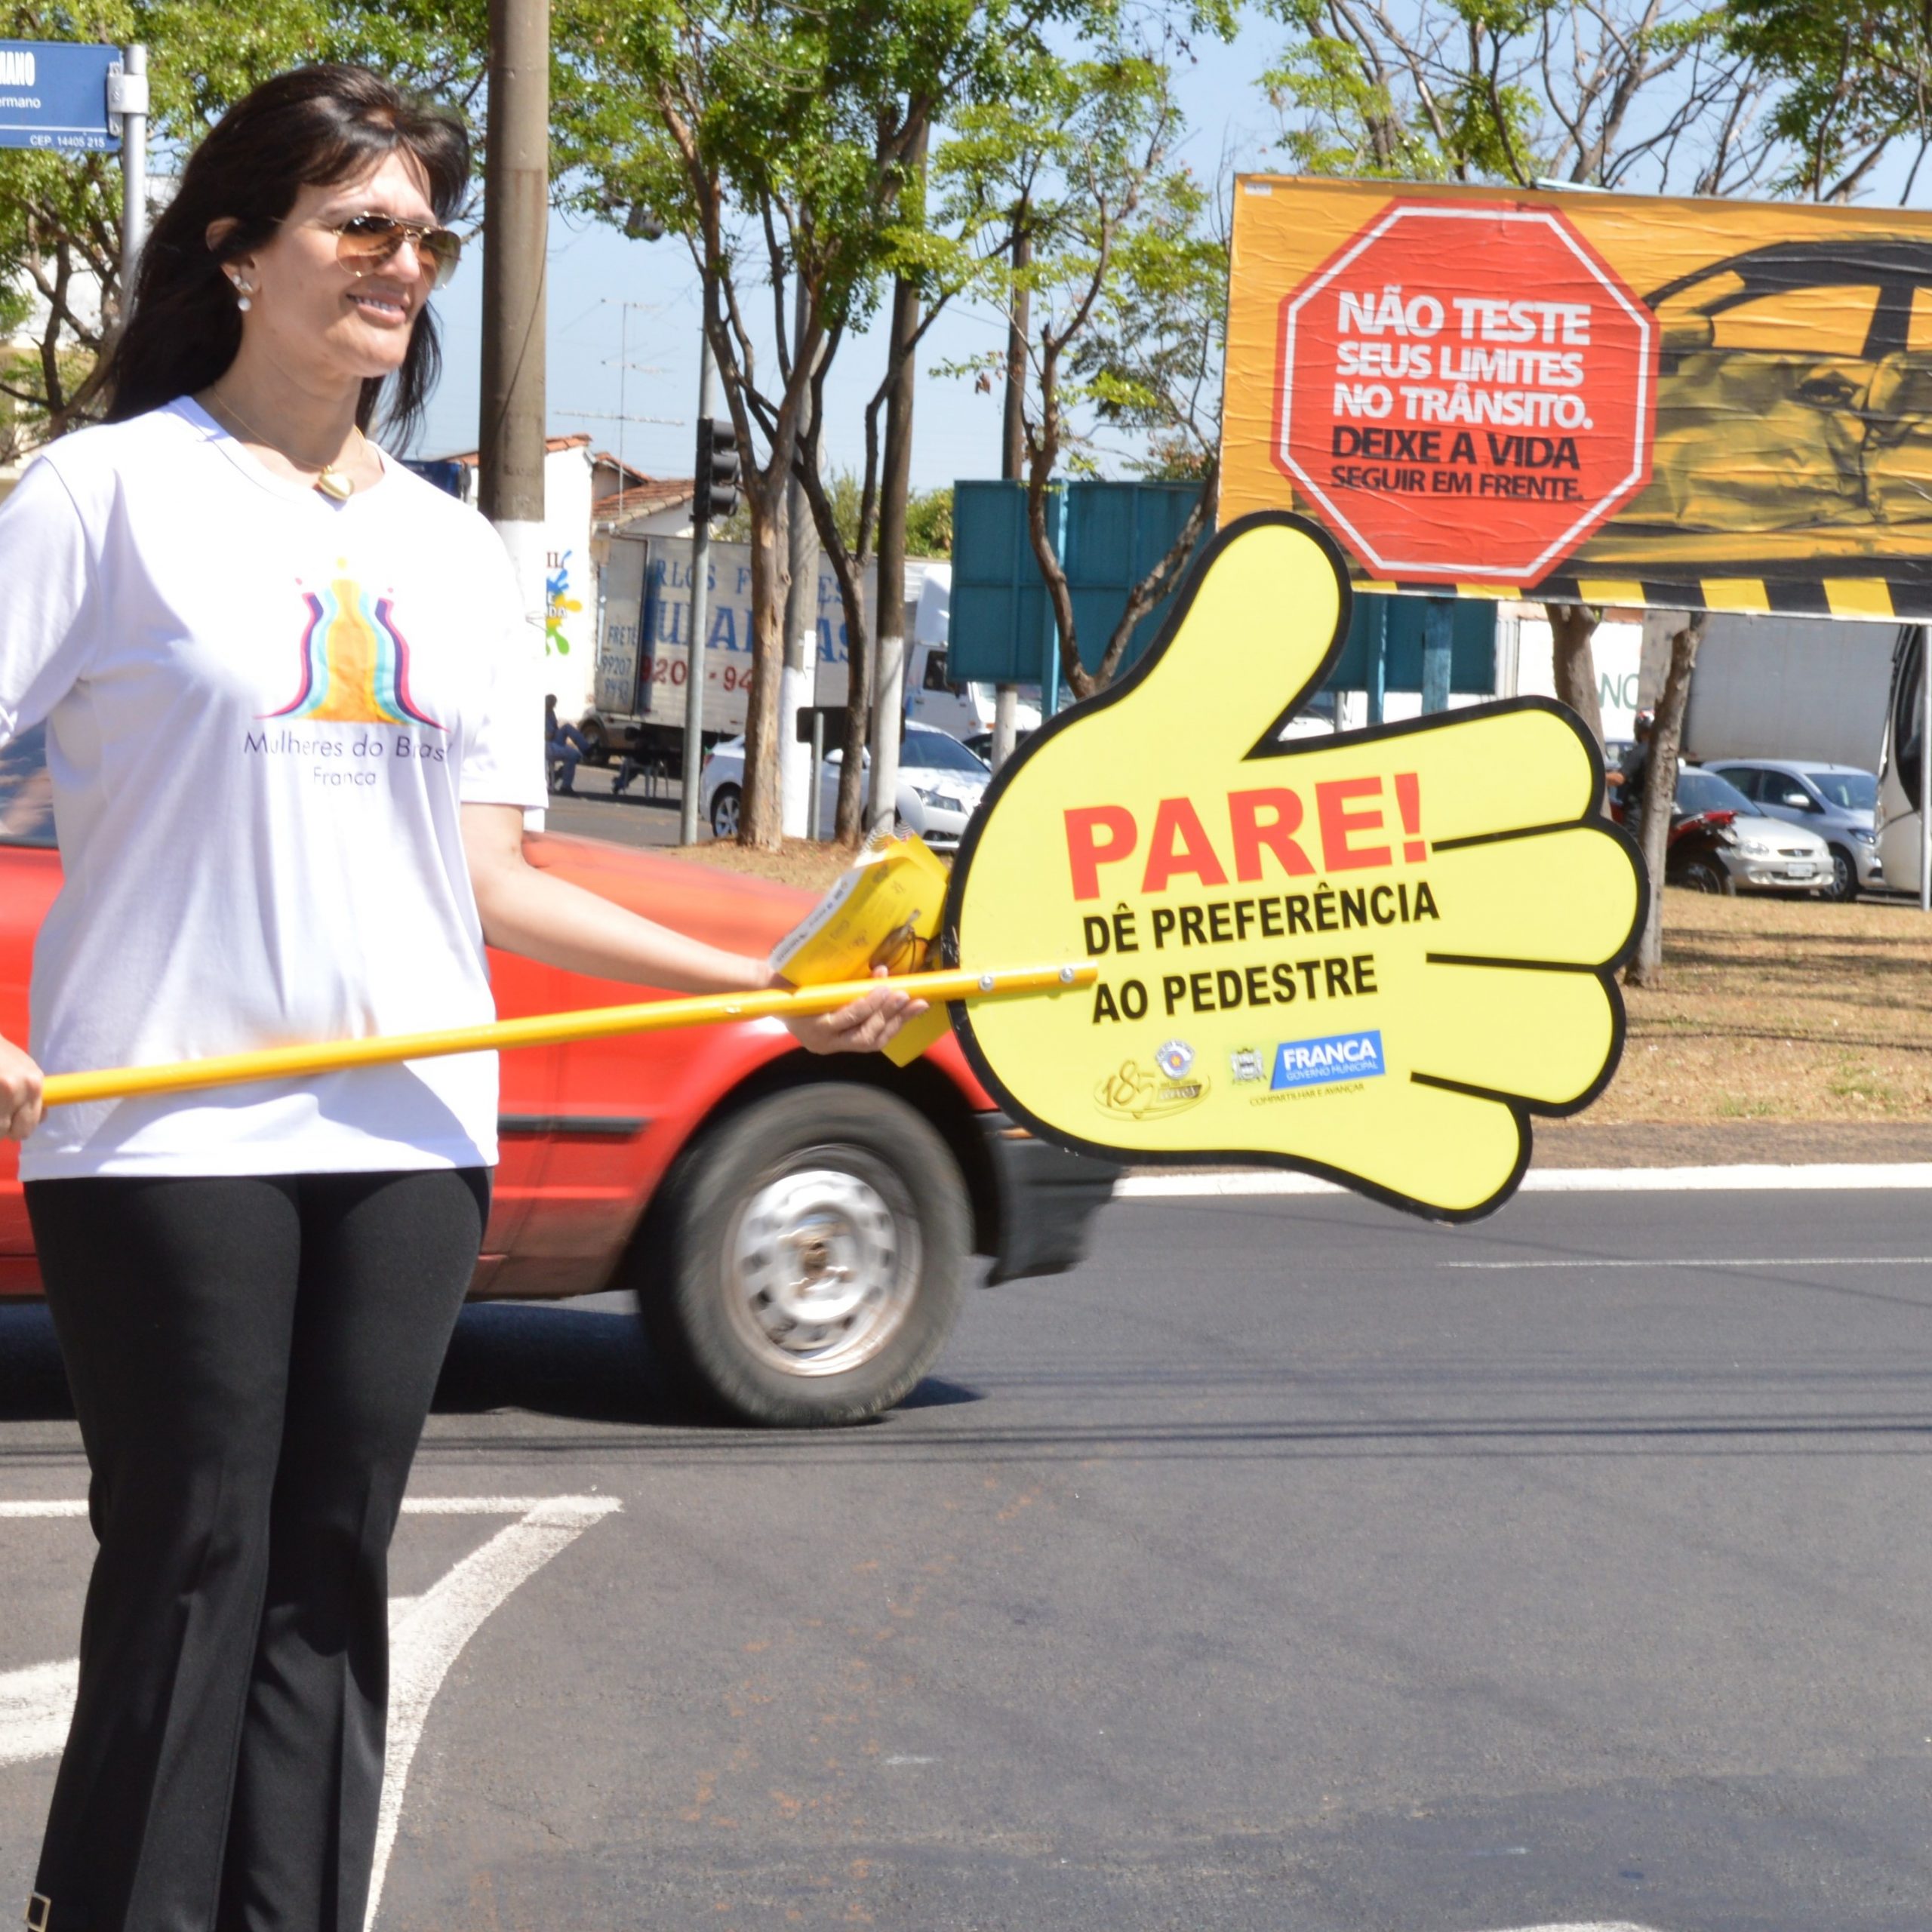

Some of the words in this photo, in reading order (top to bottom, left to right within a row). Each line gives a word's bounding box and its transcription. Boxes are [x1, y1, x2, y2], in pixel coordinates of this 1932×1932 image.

[0, 97, 42, 109] rmano
[1337, 285, 1445, 338] NÃO
[1452, 297, 1592, 346] TESTE
[1336, 340, 1432, 380] SEUS
[1439, 345, 1584, 388] LIMITES
[1333, 382, 1394, 419] NO
[1399, 382, 1594, 430] TRÂNSITO.
[1331, 425, 1442, 463] DEIXE
[1448, 432, 1477, 466] A
[1486, 432, 1580, 471] VIDA
[1331, 465, 1426, 493] SEGUIR
[1432, 471, 1472, 494] EM
[1478, 473, 1584, 502] FRENTE.
[244, 730, 343, 757] Mulheres
[352, 734, 383, 757] do
[313, 766, 377, 786] Franca
[1063, 772, 1427, 900] PARE!
[1082, 902, 1140, 955] DÊ
[1152, 881, 1440, 949] PREFERÊNCIA
[1092, 979, 1149, 1024] AO
[1163, 953, 1378, 1016] PEDESTRE
[1283, 1038, 1377, 1071] FRANCA
[1286, 1066, 1331, 1081] GOVERNO
[1331, 1061, 1379, 1076] MUNICIPAL
[1249, 1090, 1317, 1106] COMPARTILHAR
